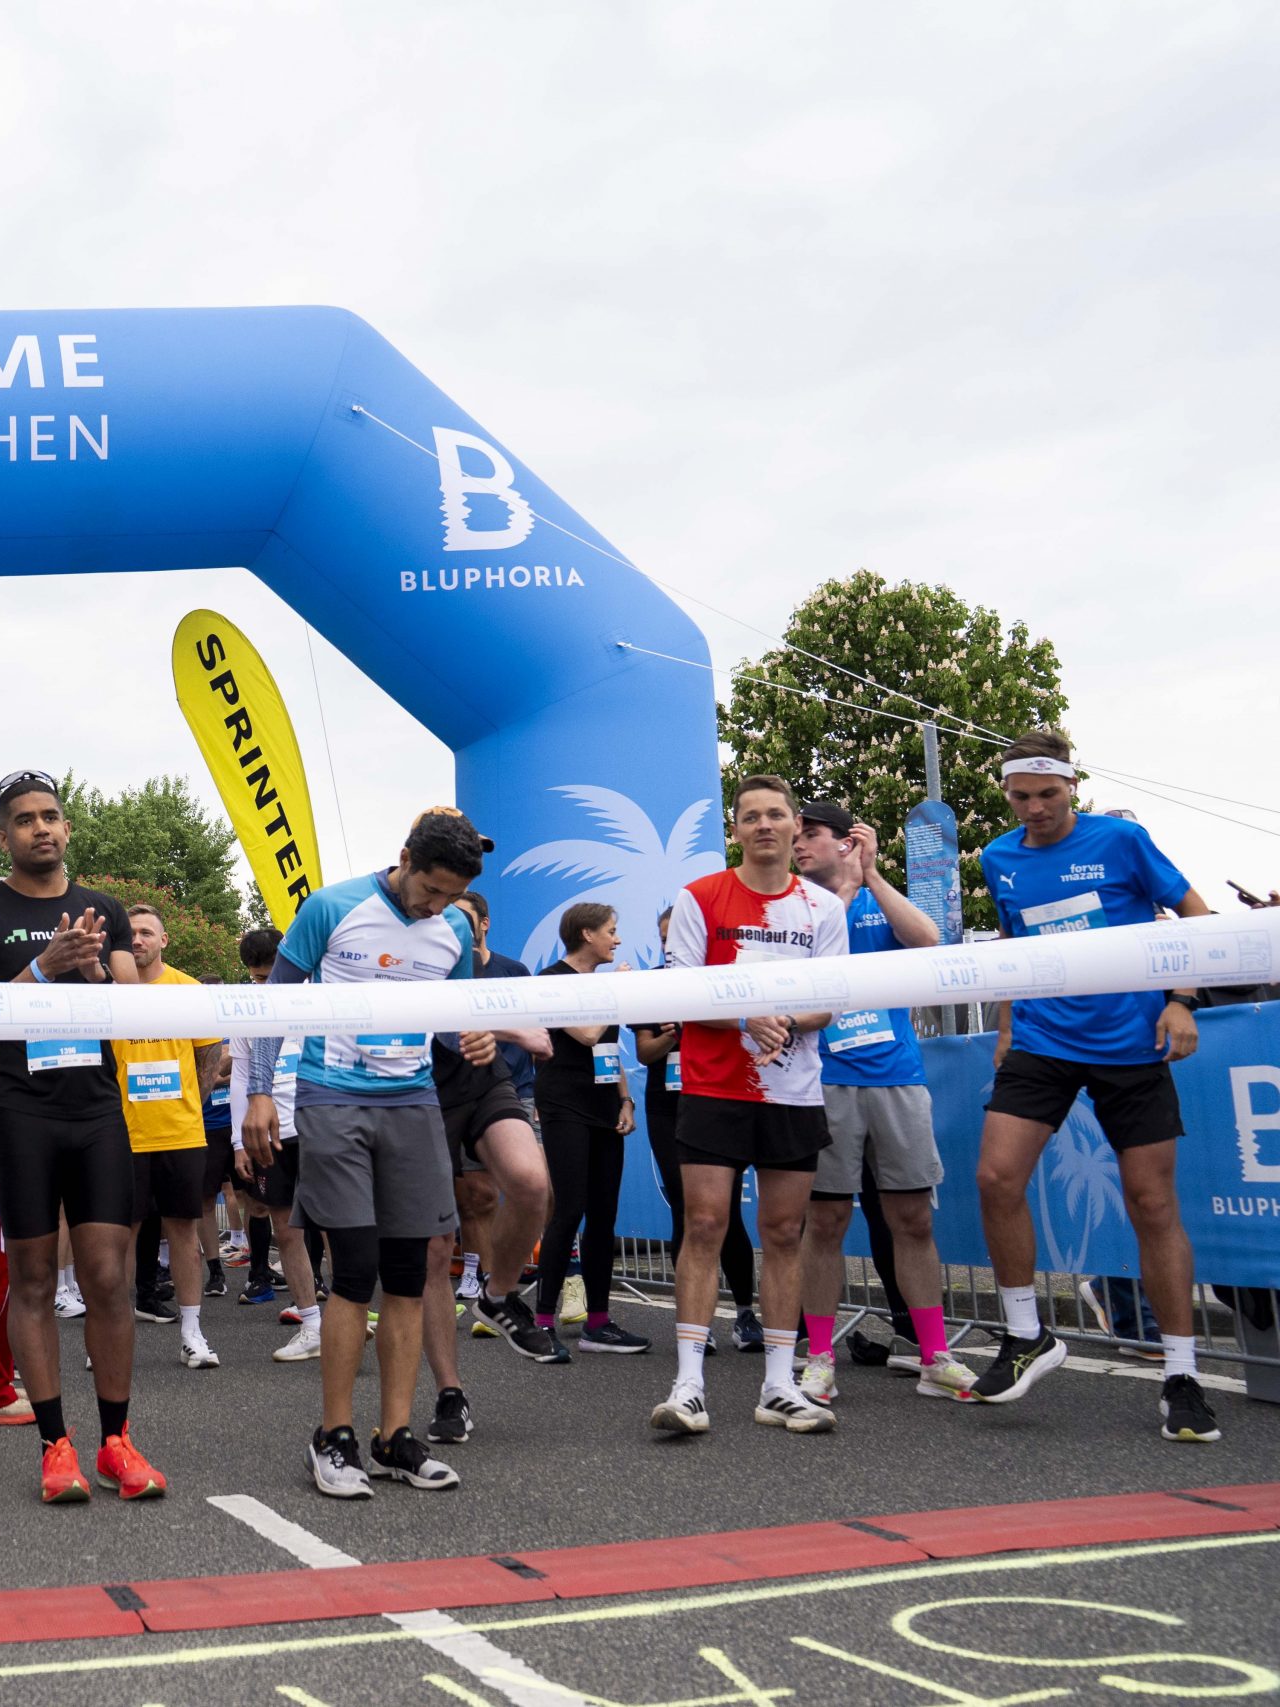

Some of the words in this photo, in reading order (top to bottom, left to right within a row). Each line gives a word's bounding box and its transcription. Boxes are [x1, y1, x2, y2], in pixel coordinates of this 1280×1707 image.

[432, 426, 535, 551] B
[400, 565, 585, 592] BLUPHORIA
[196, 633, 312, 915] SPRINTER
[1039, 914, 1090, 935] Michel
[716, 927, 788, 944] Firmenlauf
[1148, 940, 1188, 952] FIRMEN
[1208, 948, 1226, 960] KÖLN
[1151, 954, 1190, 973] LAUF
[940, 967, 980, 986] LAUF
[714, 982, 756, 999] LAUF
[221, 1001, 267, 1016] LAUF
[472, 995, 518, 1010] LAUF
[837, 1012, 879, 1030] Cedric
[136, 1075, 171, 1087] Marvin
[1212, 1196, 1280, 1217] BLUPH
